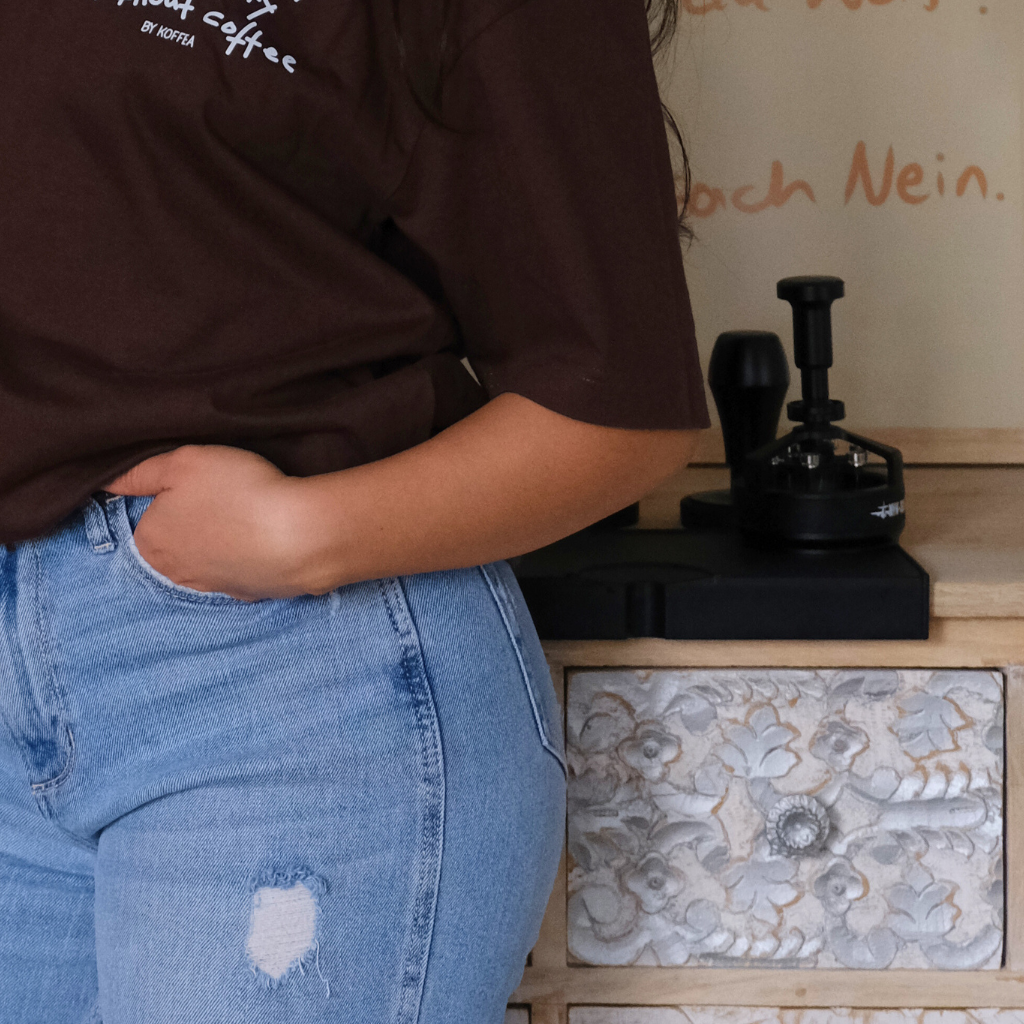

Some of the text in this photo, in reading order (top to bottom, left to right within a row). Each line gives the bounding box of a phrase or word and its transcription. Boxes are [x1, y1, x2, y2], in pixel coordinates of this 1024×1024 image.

[140, 20, 195, 48] BY KOFFEA
[202, 10, 297, 74] coffee
[675, 160, 817, 219] ach
